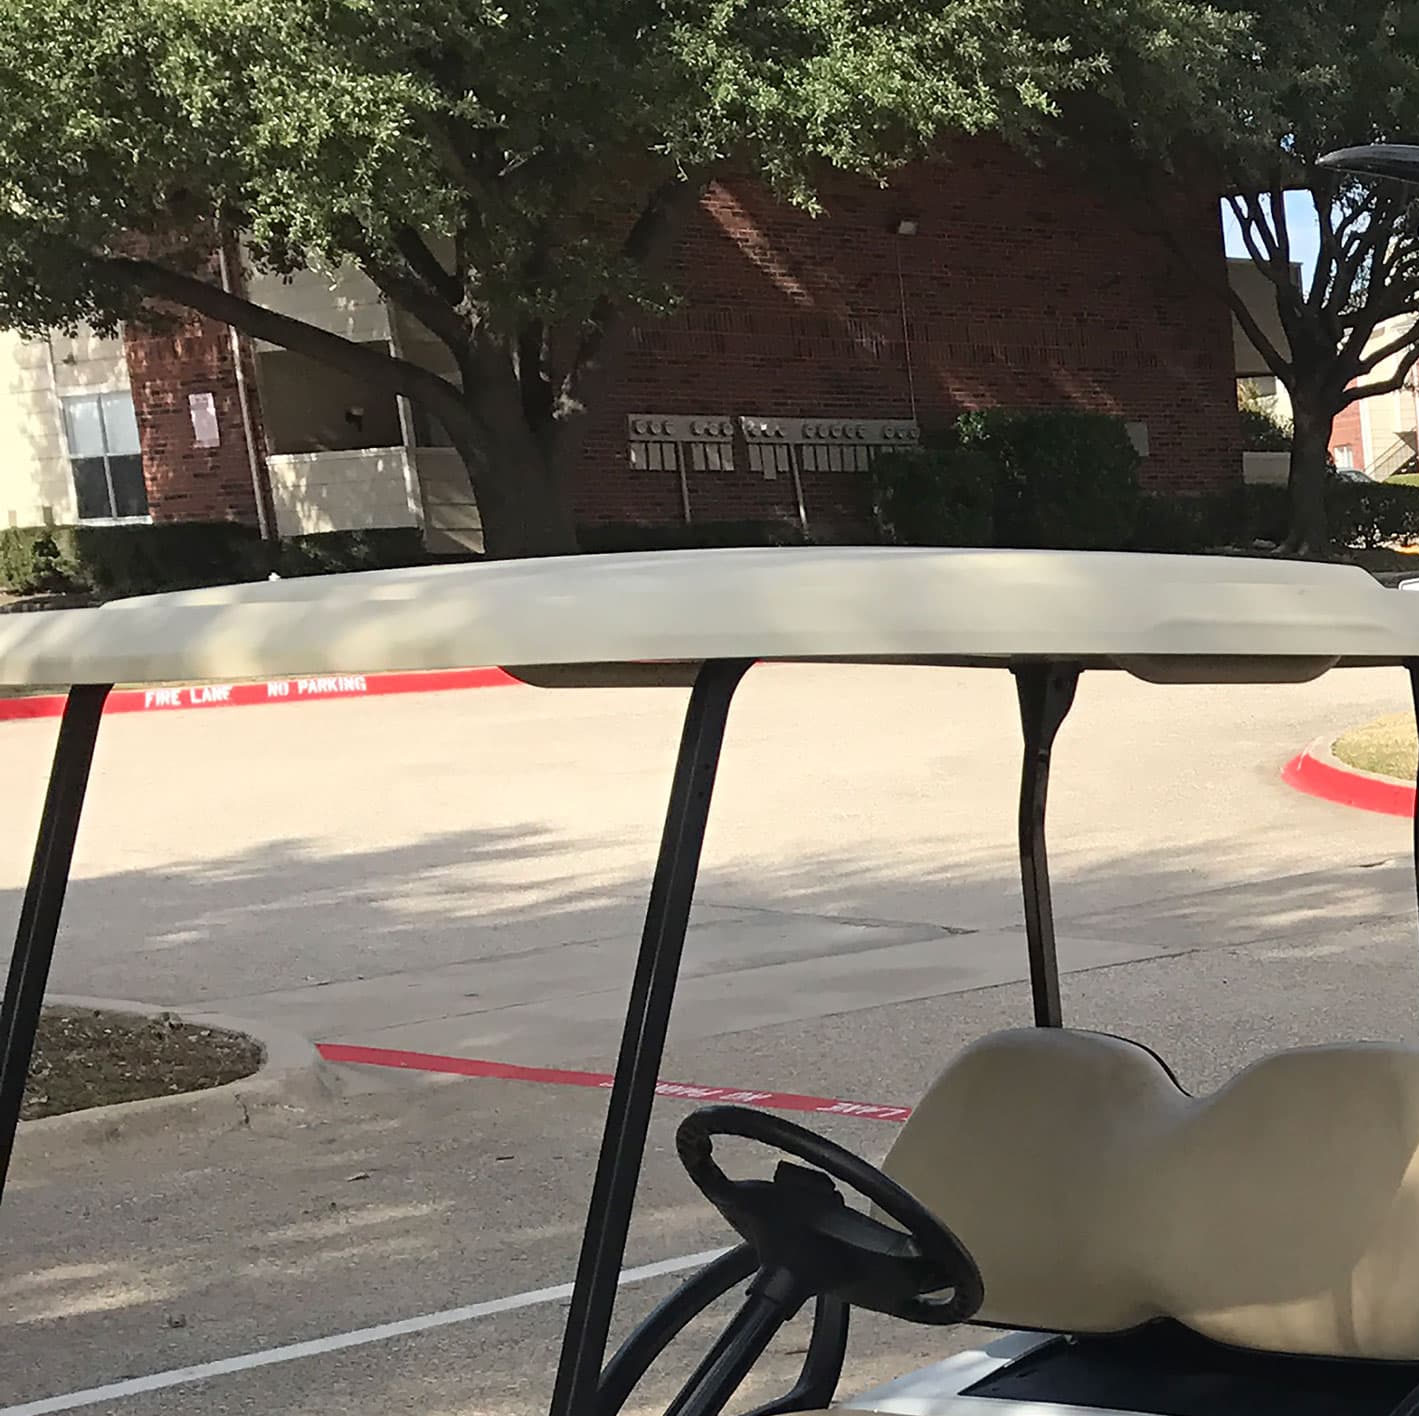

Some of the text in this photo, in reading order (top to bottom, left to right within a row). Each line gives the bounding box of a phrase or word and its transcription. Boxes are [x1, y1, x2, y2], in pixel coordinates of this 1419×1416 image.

[144, 676, 368, 709] FIRE LANE NO PARKING
[815, 1101, 907, 1118] LANE
